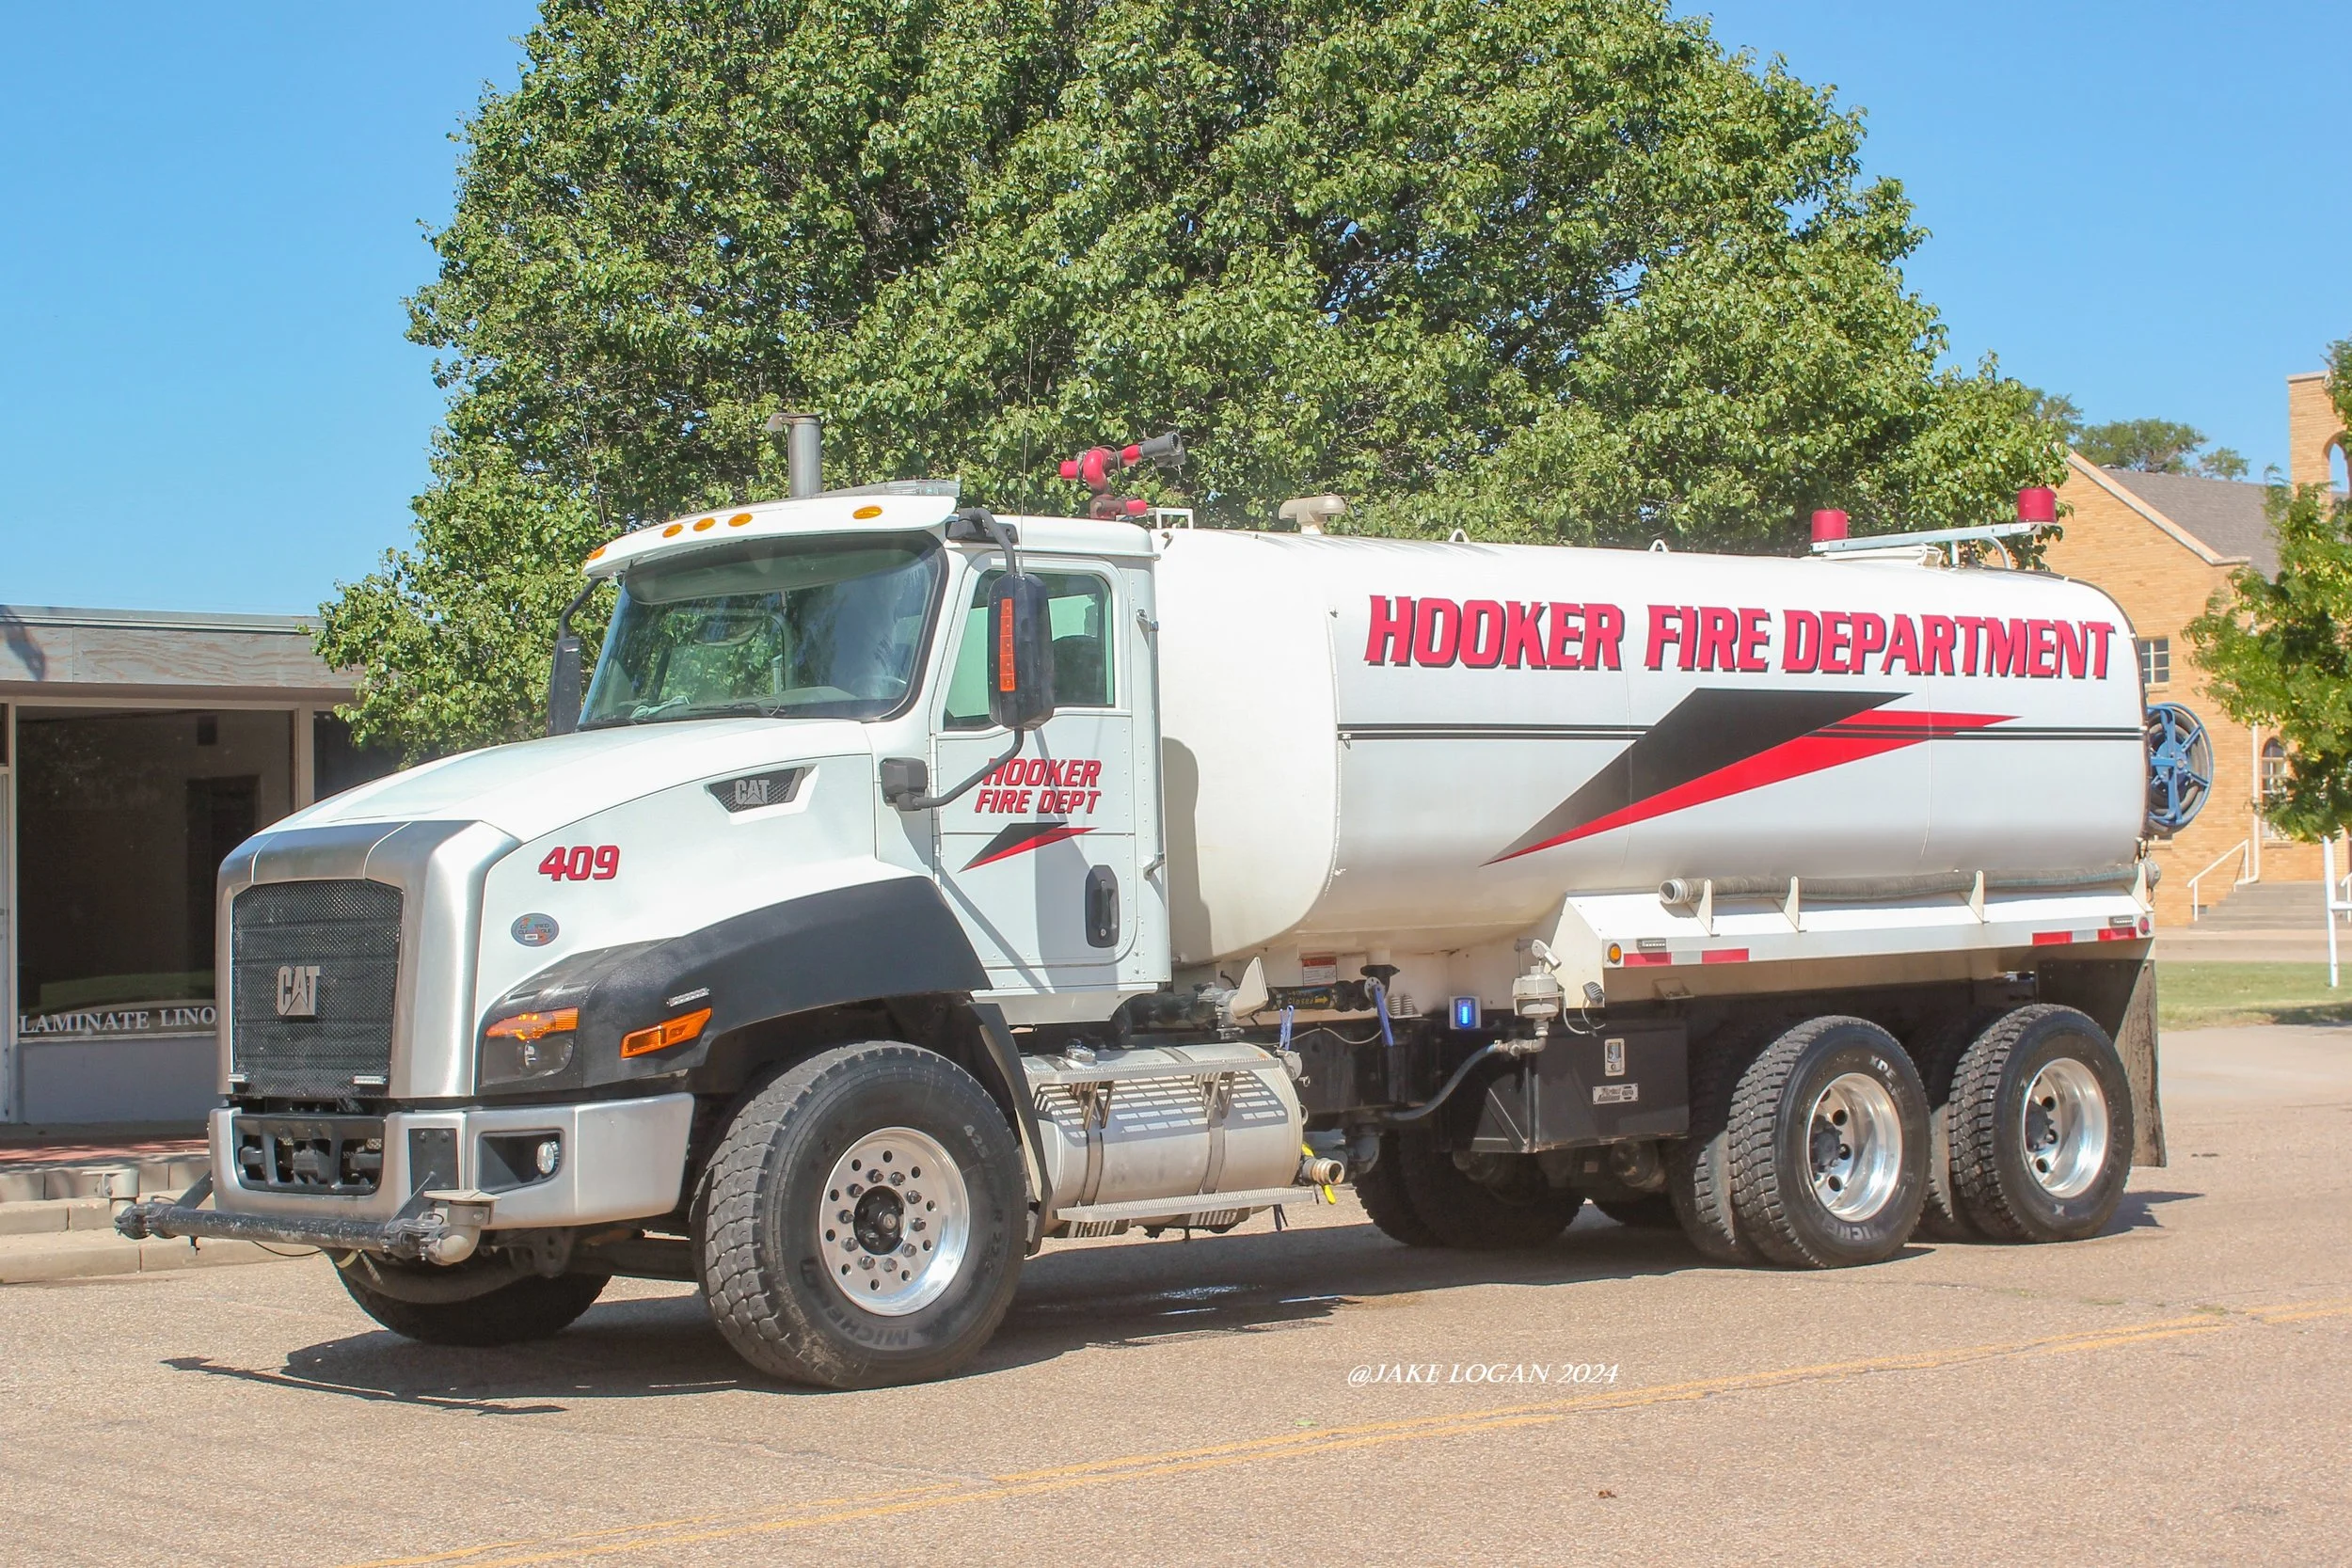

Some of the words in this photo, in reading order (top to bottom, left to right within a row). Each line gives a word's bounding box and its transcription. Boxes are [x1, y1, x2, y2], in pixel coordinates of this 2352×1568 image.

[1363, 594, 1625, 671] HOOKER
[1644, 605, 1771, 673] FIRE
[1781, 610, 2116, 680] DEPARTMENT
[982, 758, 1102, 786] HOOKER
[735, 779, 770, 804] CAT
[974, 789, 1033, 814] FIRE
[1036, 790, 1102, 815] DEPT
[537, 845, 620, 881] 409
[277, 965, 321, 1016] CAT
[19, 1011, 150, 1034] LAMINATE
[159, 1006, 217, 1027] LINO
